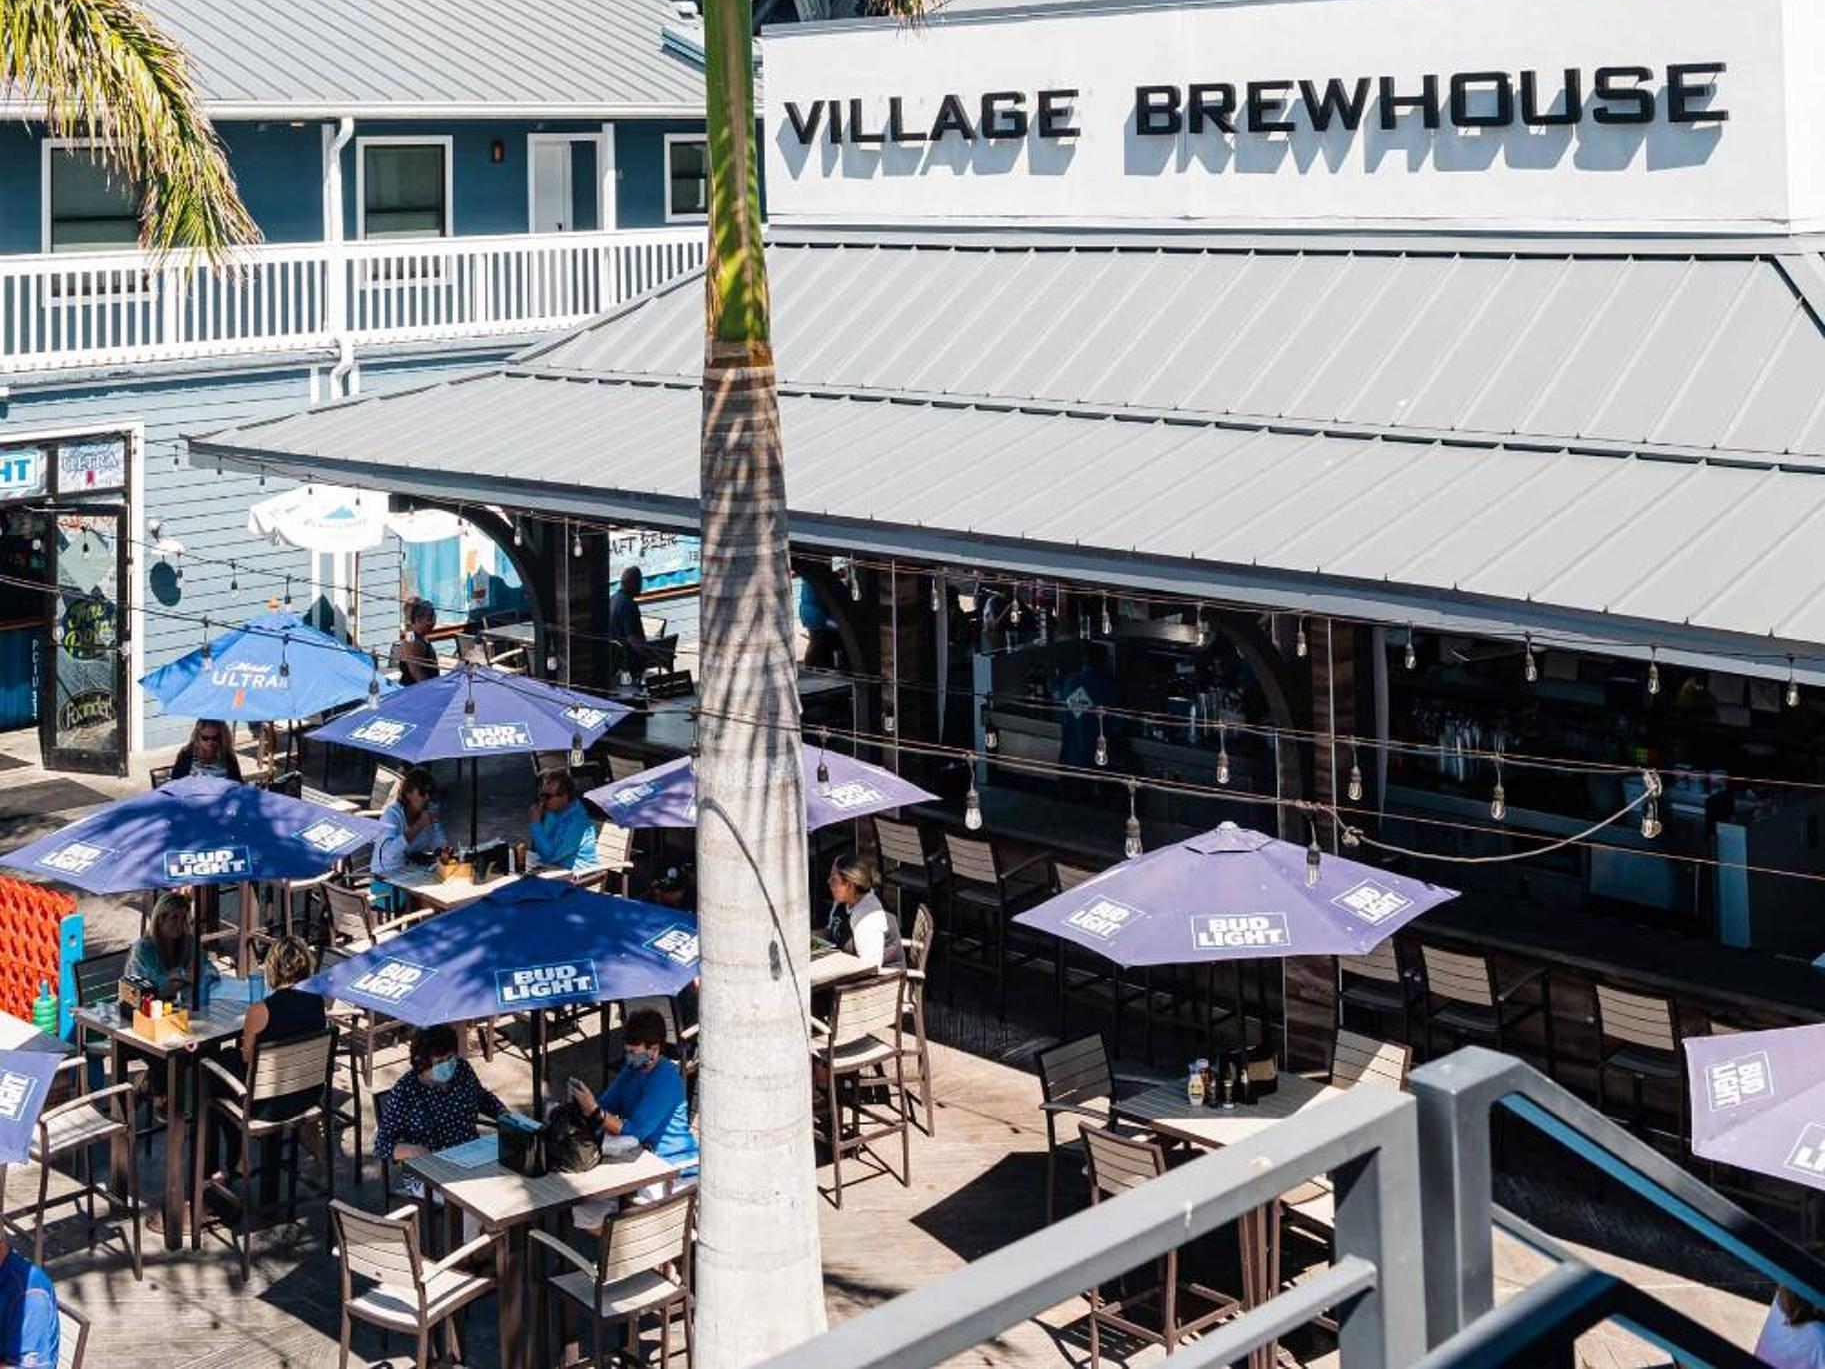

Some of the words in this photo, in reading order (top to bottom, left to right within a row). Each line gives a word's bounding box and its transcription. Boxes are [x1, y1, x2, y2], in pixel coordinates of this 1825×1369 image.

[784, 89, 1080, 145] VILLAGE
[1136, 62, 1729, 135] BREWHOUSE
[212, 671, 278, 688] ULTRA
[471, 726, 517, 739] BUD
[179, 850, 234, 865] BUD
[169, 859, 246, 877] LIGHT
[1090, 900, 1130, 923] BUD
[1068, 910, 1121, 937] LIGHT
[1208, 916, 1269, 932] BUD
[1198, 929, 1284, 947] LIGHT
[377, 962, 422, 983] BUD
[513, 965, 577, 985] BUD
[353, 973, 414, 999] LIGHT
[503, 976, 592, 1001] LIGHT
[1737, 1059, 1767, 1095] BUD
